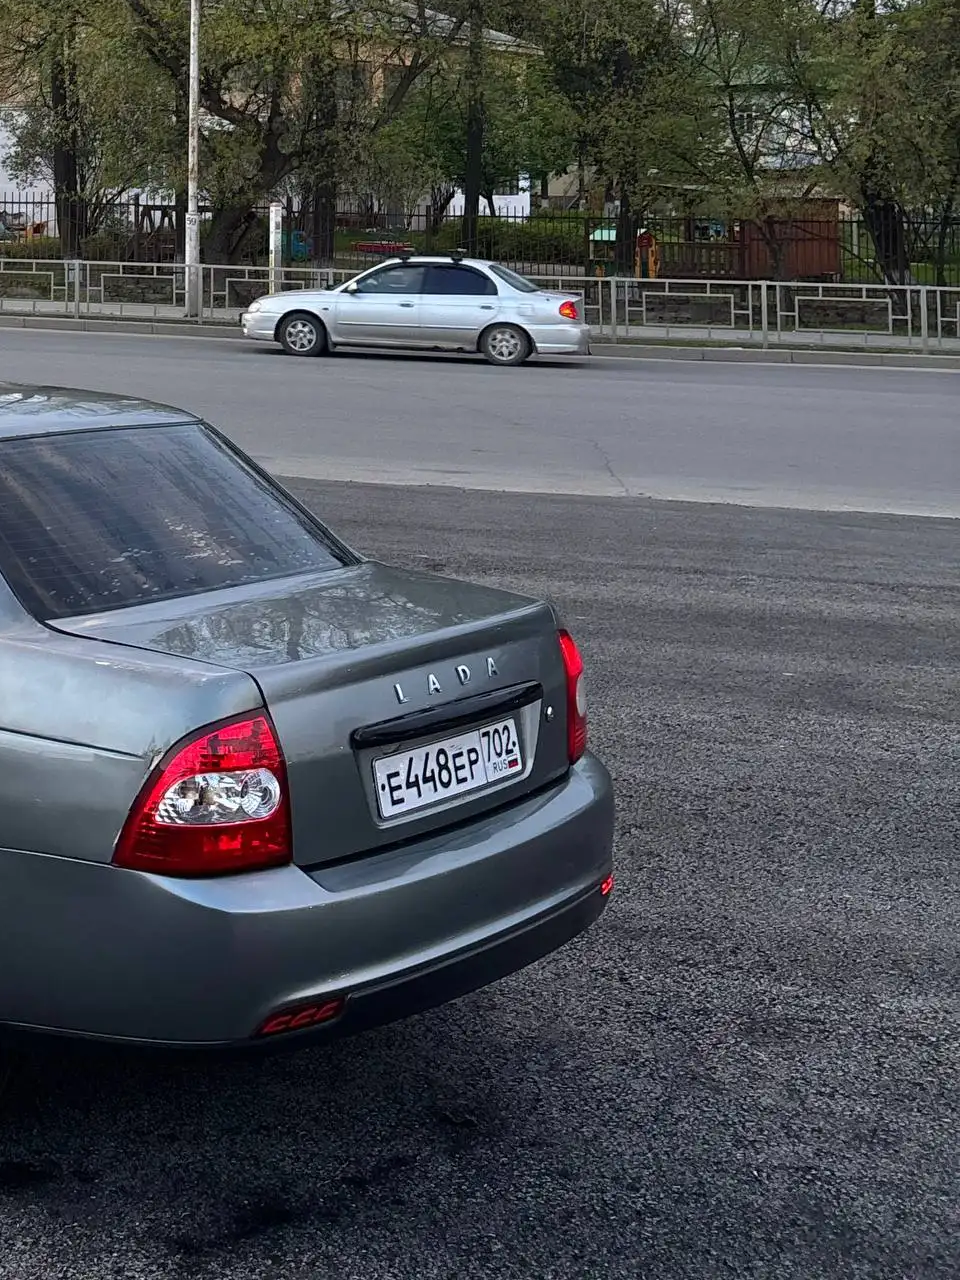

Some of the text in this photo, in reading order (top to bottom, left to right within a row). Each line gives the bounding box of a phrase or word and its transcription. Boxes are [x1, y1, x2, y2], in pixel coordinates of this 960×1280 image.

[394, 657, 499, 704] LADA
[481, 725, 513, 763] 702
[493, 758, 508, 774] RUS
